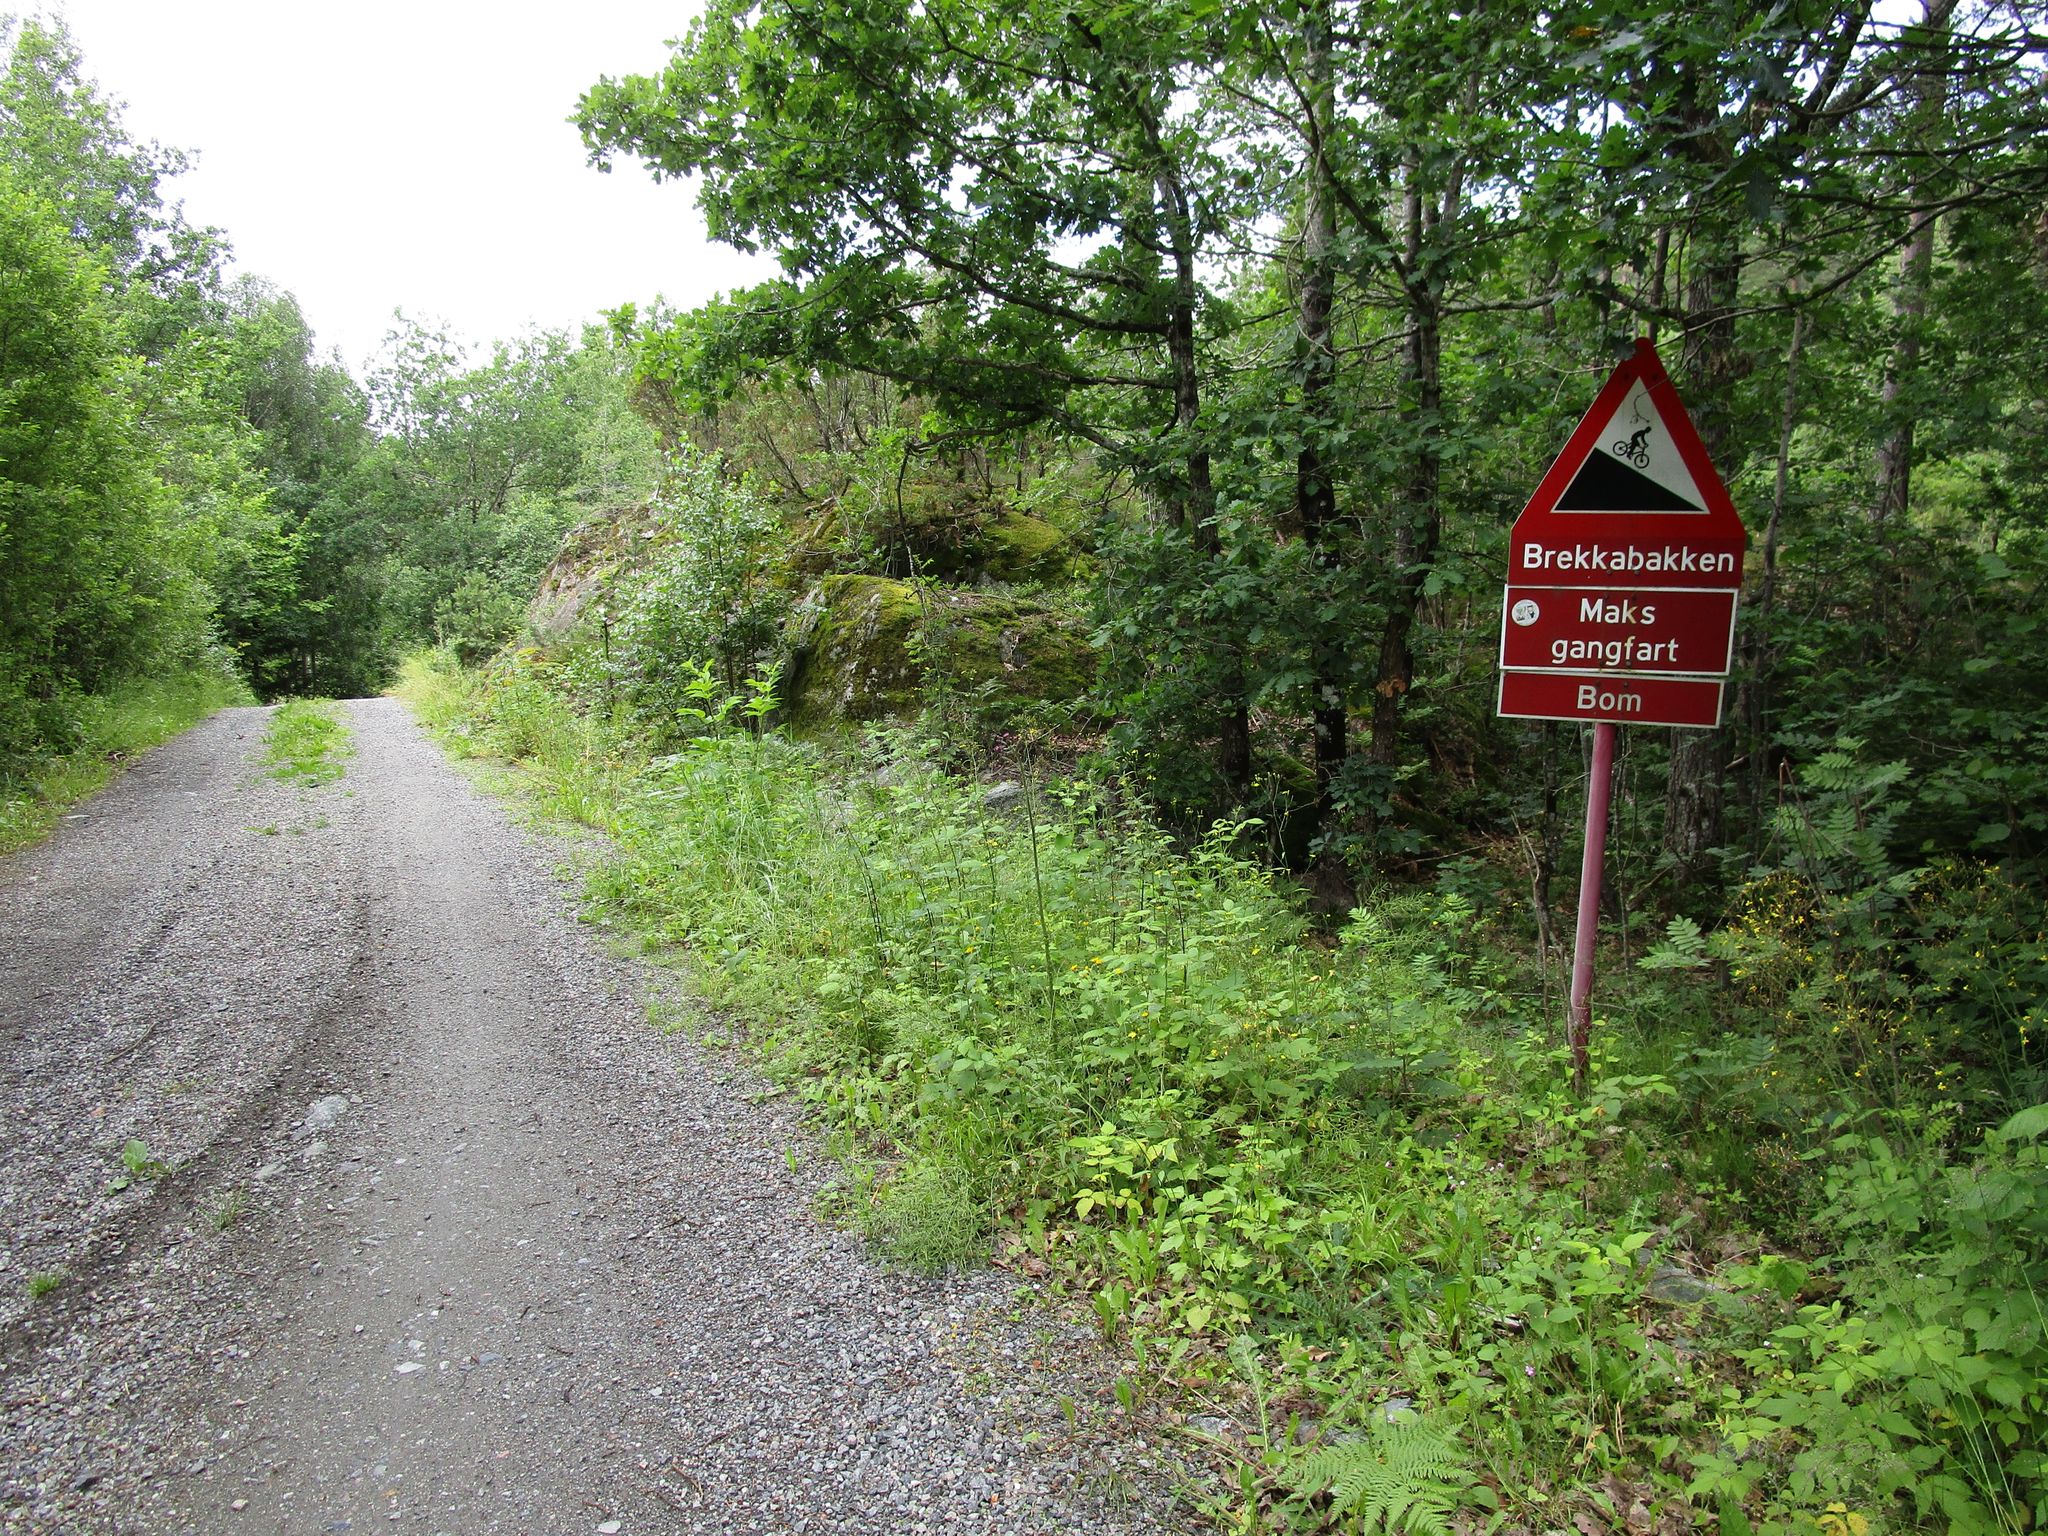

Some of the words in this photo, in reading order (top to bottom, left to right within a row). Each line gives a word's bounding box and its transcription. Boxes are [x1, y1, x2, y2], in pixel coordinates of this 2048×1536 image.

[1523, 543, 1734, 572] Brekkabakken
[1579, 598, 1656, 624] Maks
[1551, 636, 1679, 666] gangfart
[1577, 685, 1642, 712] Bom
